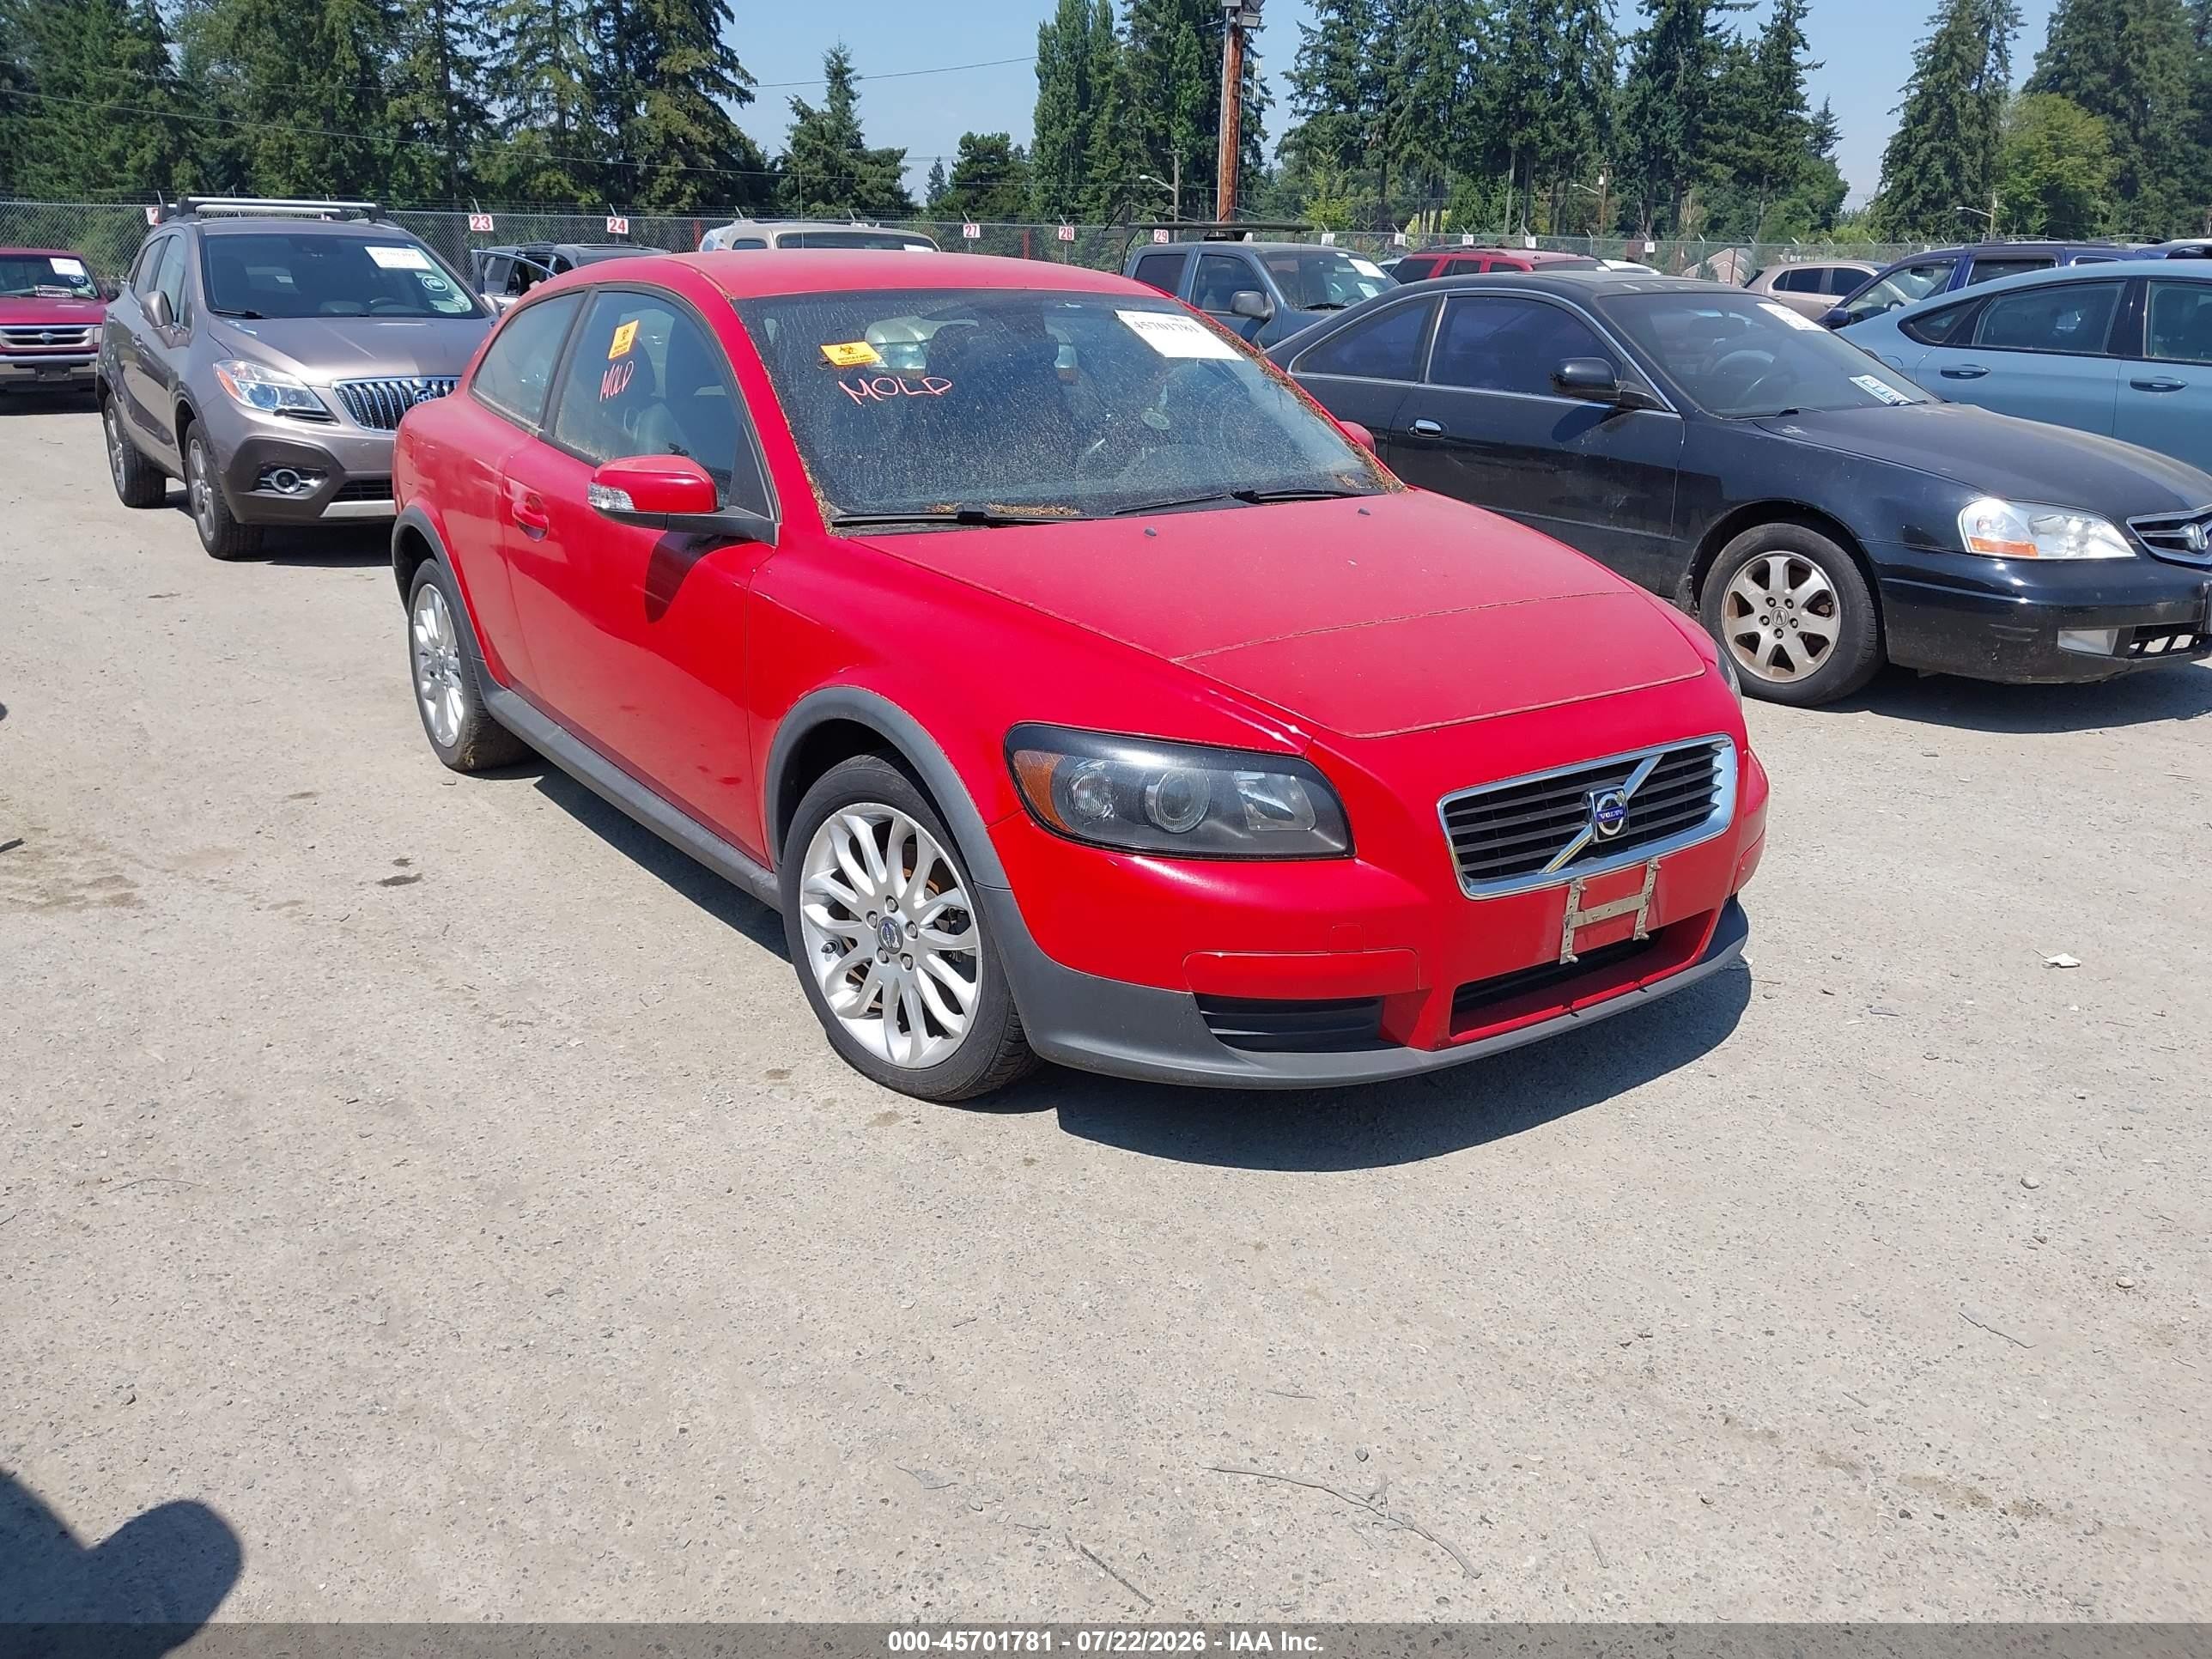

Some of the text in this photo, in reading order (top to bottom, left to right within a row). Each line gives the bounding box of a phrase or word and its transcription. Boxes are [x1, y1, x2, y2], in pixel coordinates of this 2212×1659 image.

[471, 216, 490, 229] 23
[609, 218, 626, 232] 24
[964, 225, 977, 237] 27
[1060, 227, 1073, 240] 28
[1156, 230, 1169, 242] 29
[599, 361, 634, 402] MOLD
[838, 377, 952, 404] MOLD
[1599, 809, 1623, 819] VOLVO
